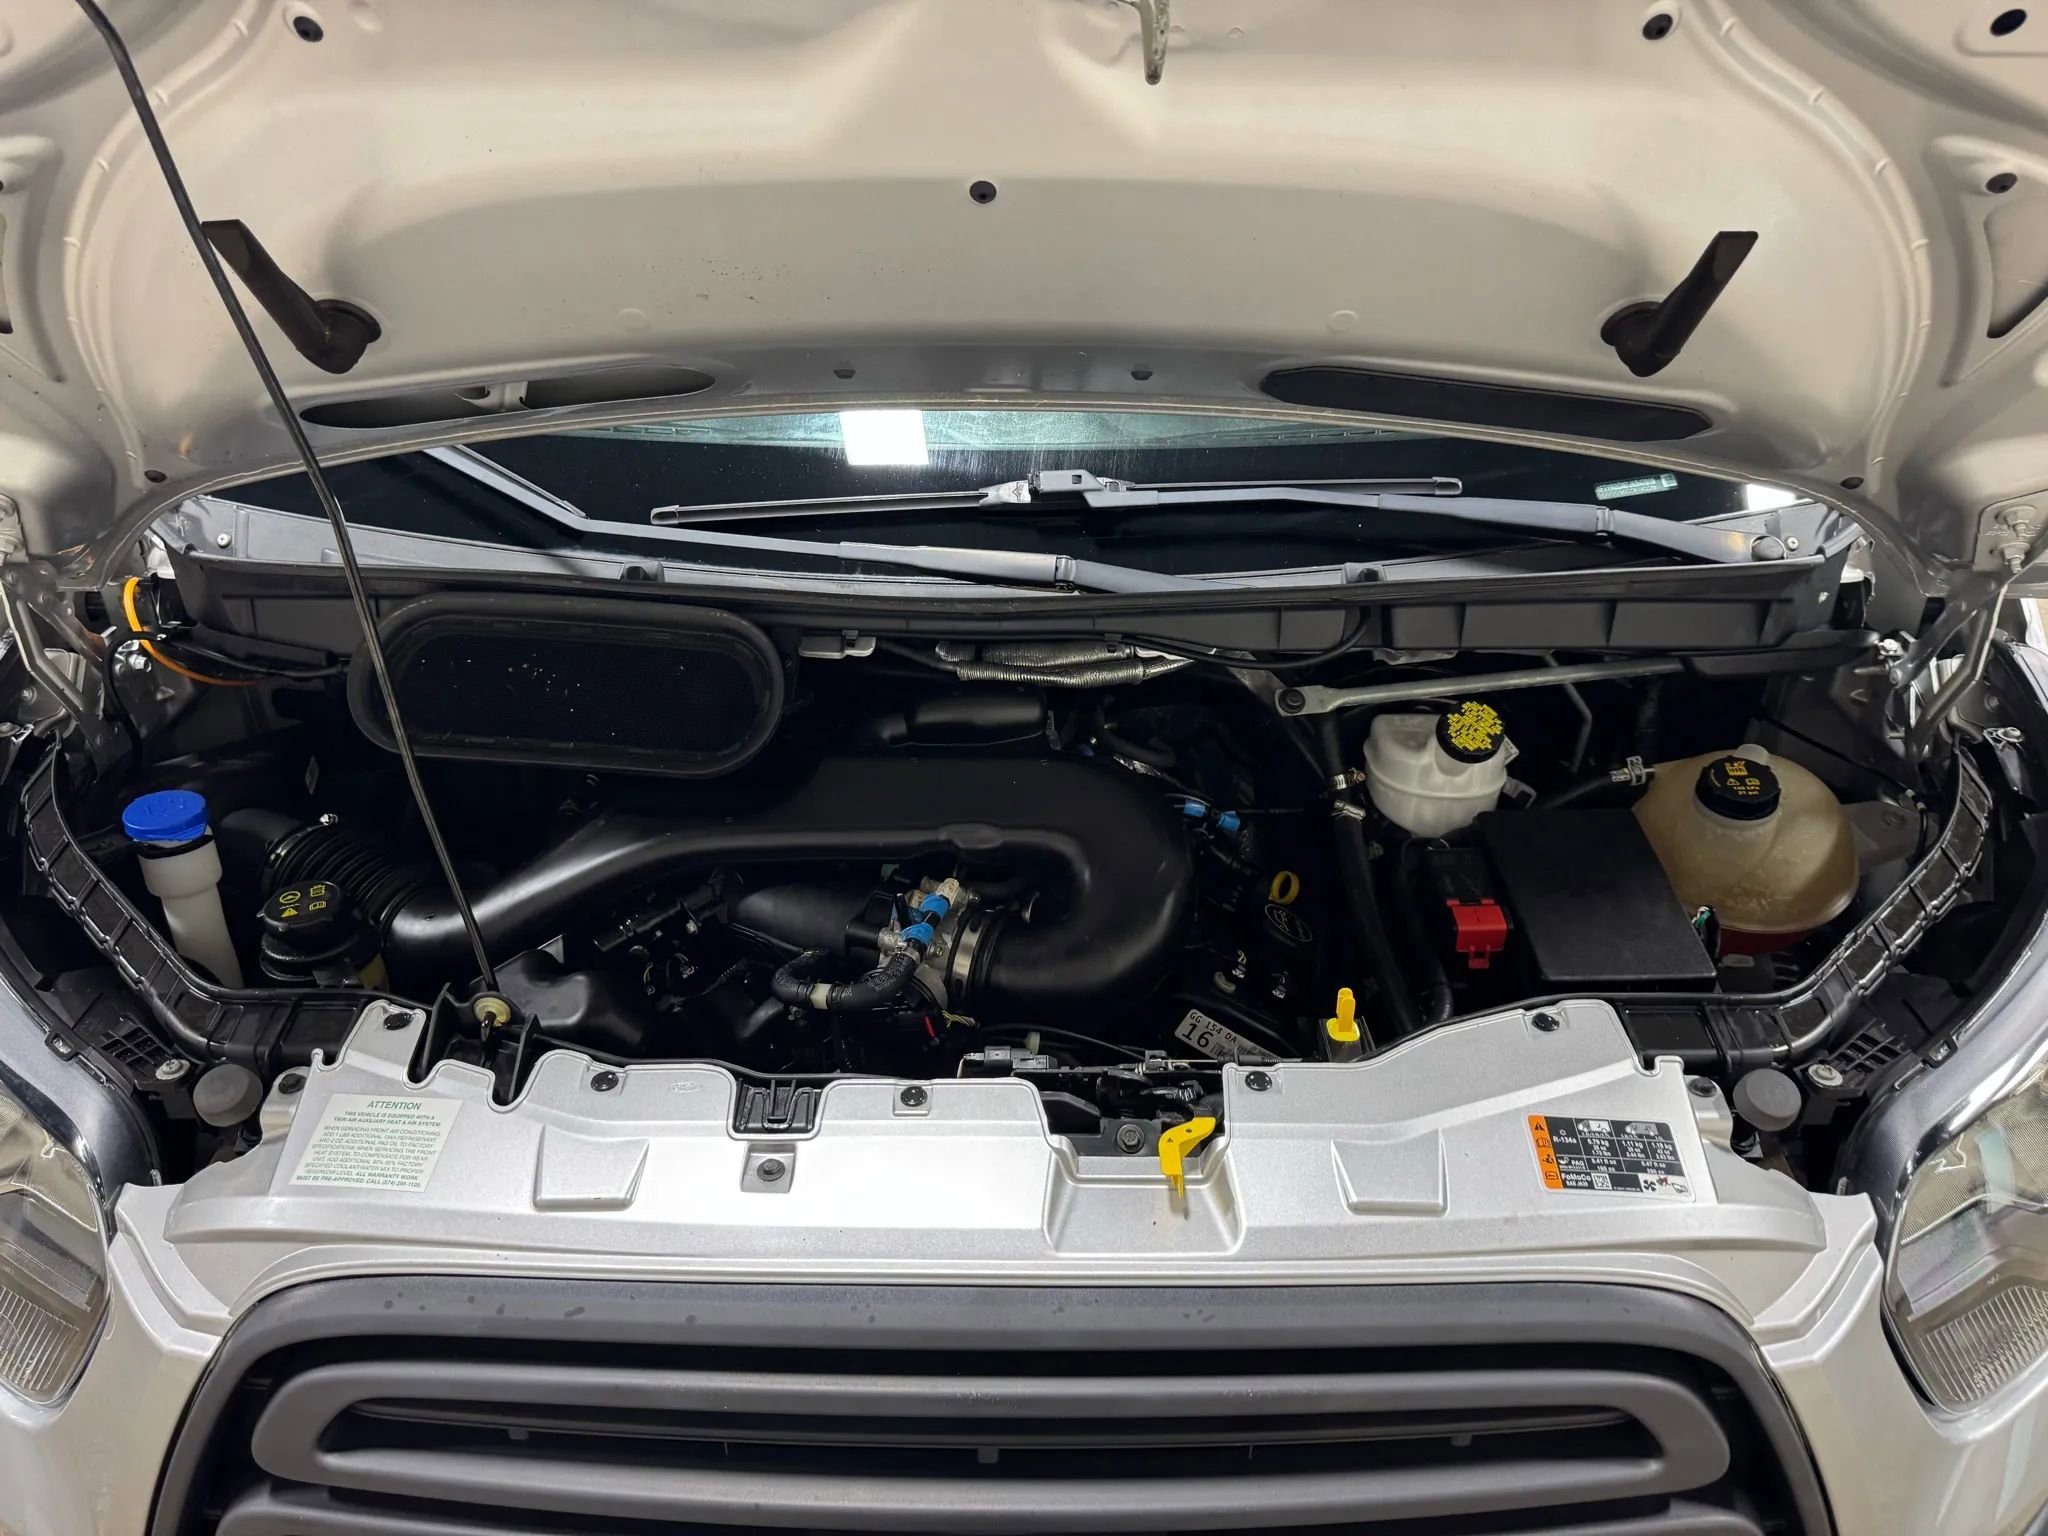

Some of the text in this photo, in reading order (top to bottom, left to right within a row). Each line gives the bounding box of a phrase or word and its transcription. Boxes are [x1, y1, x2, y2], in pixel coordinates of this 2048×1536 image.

[1190, 1012, 1237, 1044] GG 154 DA
[1182, 1022, 1214, 1048] 16
[367, 1100, 422, 1110] ATTENTION
[1552, 1136, 1577, 1144] R-134a
[1561, 1172, 1592, 1182] FoMoCo
